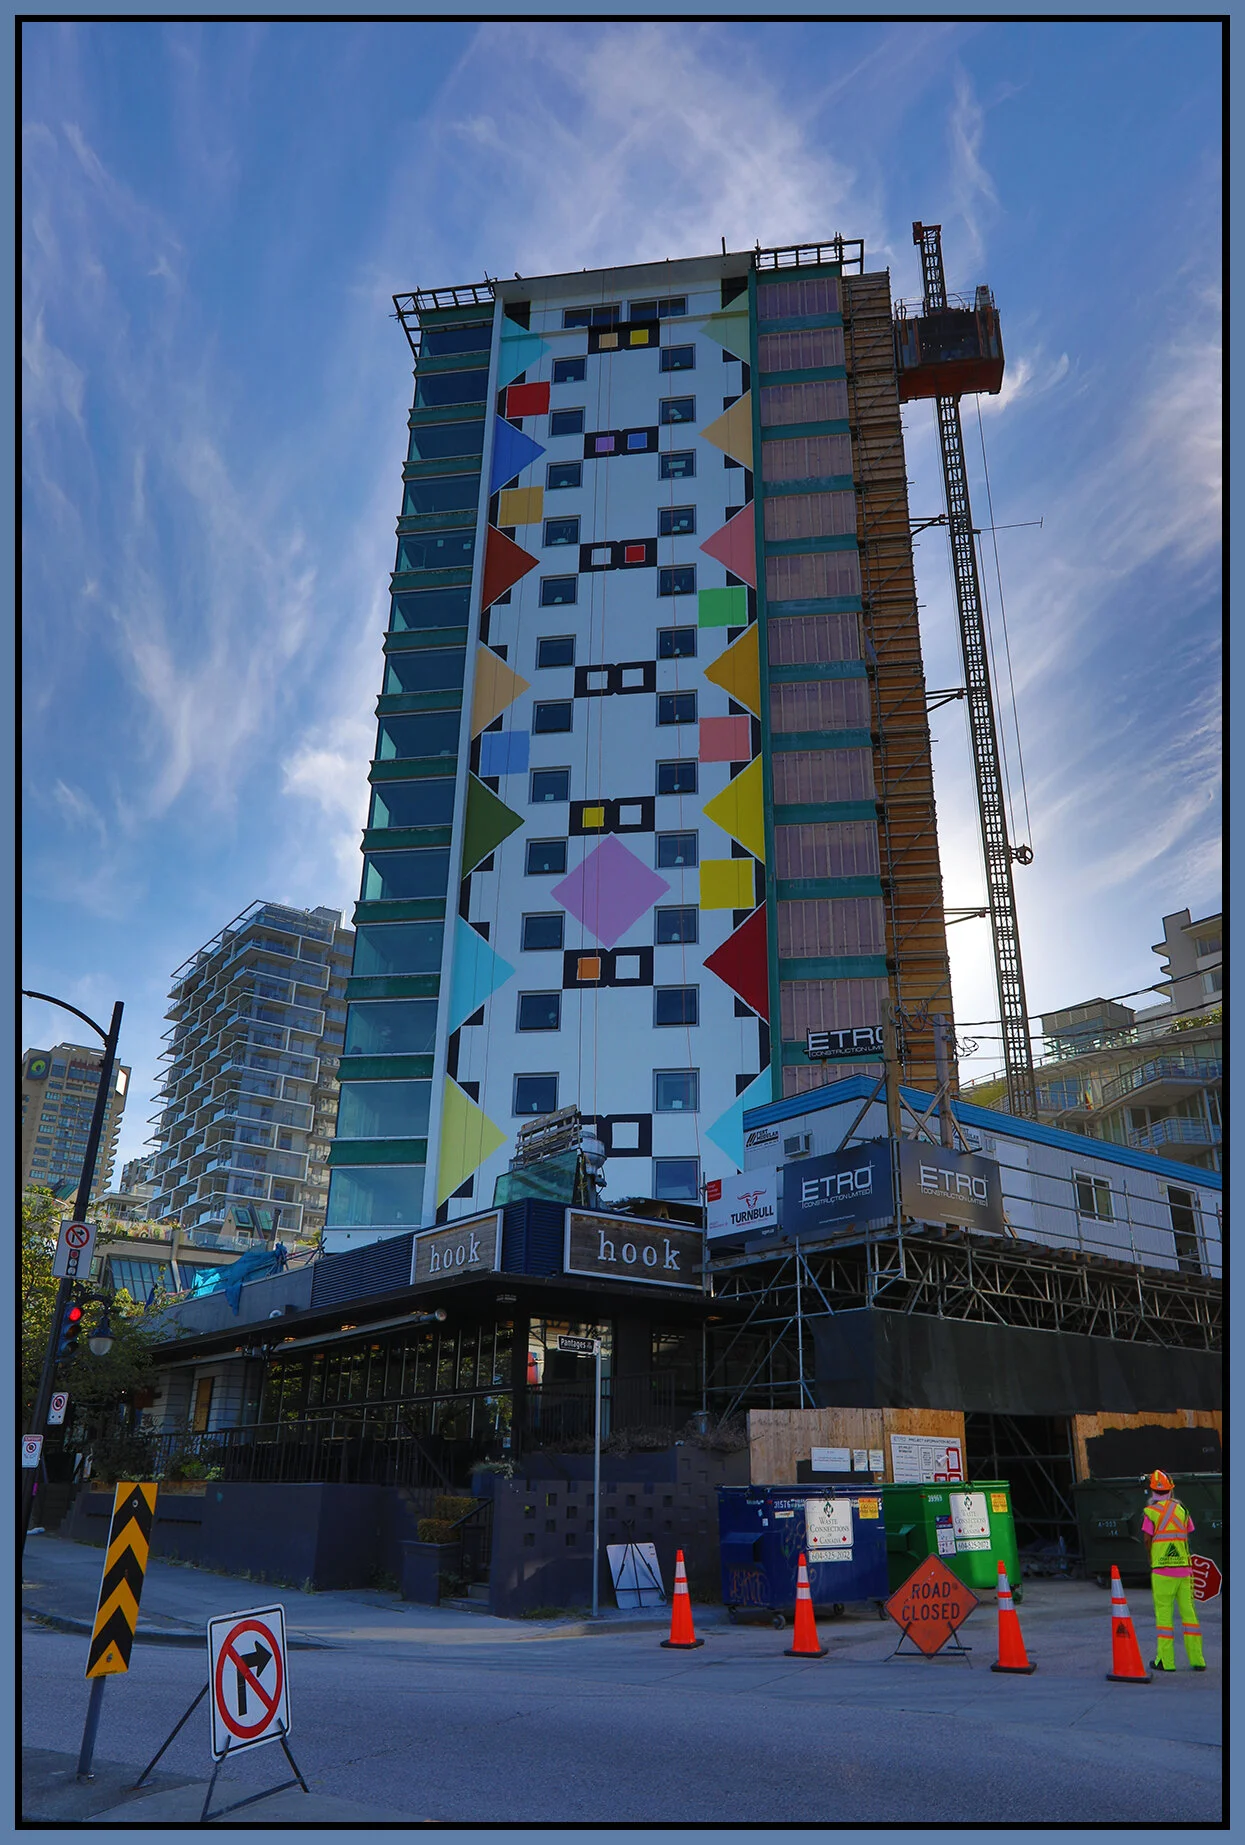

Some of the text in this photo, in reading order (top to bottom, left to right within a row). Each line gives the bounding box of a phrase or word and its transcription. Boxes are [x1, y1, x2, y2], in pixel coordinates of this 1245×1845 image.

[811, 1046, 867, 1057] CONSTRUCTION
[802, 1165, 873, 1202] ETRO
[920, 1165, 987, 1199] ETRO
[803, 1188, 871, 1209] CONSTRUCTION LIMITED
[923, 1187, 968, 1202] CONSTRUCTION
[730, 1205, 774, 1225] TURNBULL
[429, 1232, 481, 1273] hook
[597, 1230, 681, 1271] hook
[560, 1338, 586, 1350] Pantages
[809, 1524, 850, 1533] CONNECTIONS
[819, 1537, 841, 1545] CANADA
[1192, 1558, 1210, 1599] STOP
[911, 1582, 951, 1599] ROAD
[901, 1602, 960, 1621] CLOSED
